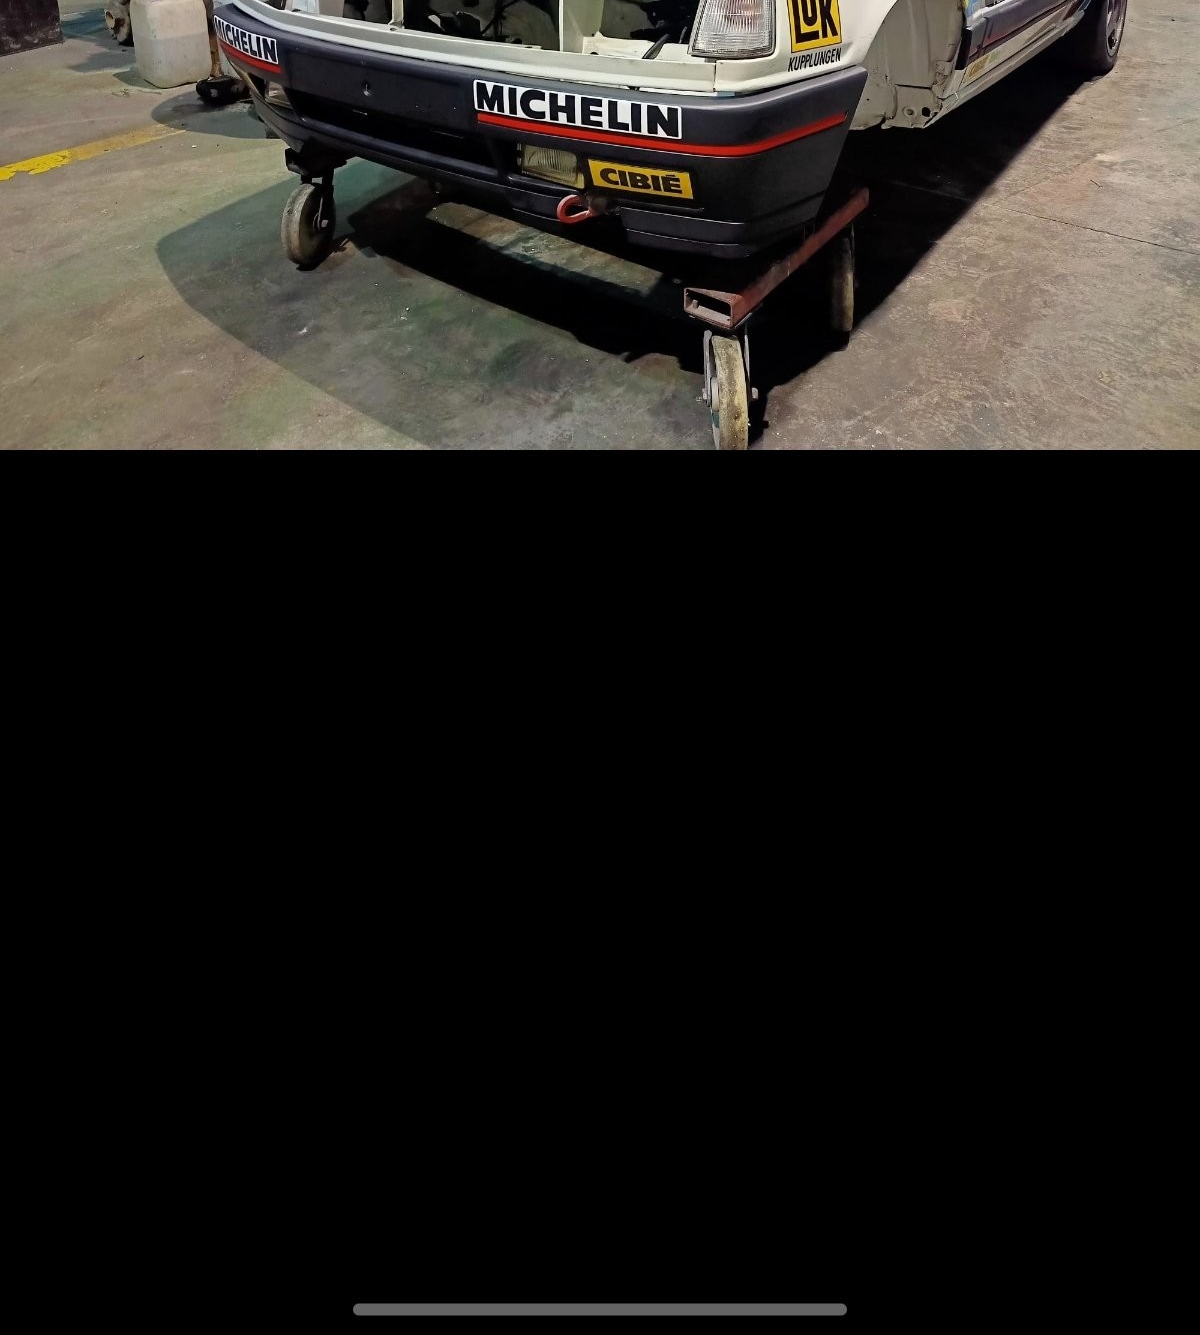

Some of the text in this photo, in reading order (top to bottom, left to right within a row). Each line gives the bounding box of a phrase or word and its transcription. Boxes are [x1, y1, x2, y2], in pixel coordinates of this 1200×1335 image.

[214, 16, 278, 63] MICHELIN
[787, 47, 843, 73] KUPPLUNGEN
[475, 81, 679, 138] MICHELIN
[599, 167, 684, 194] CIBIÉ
